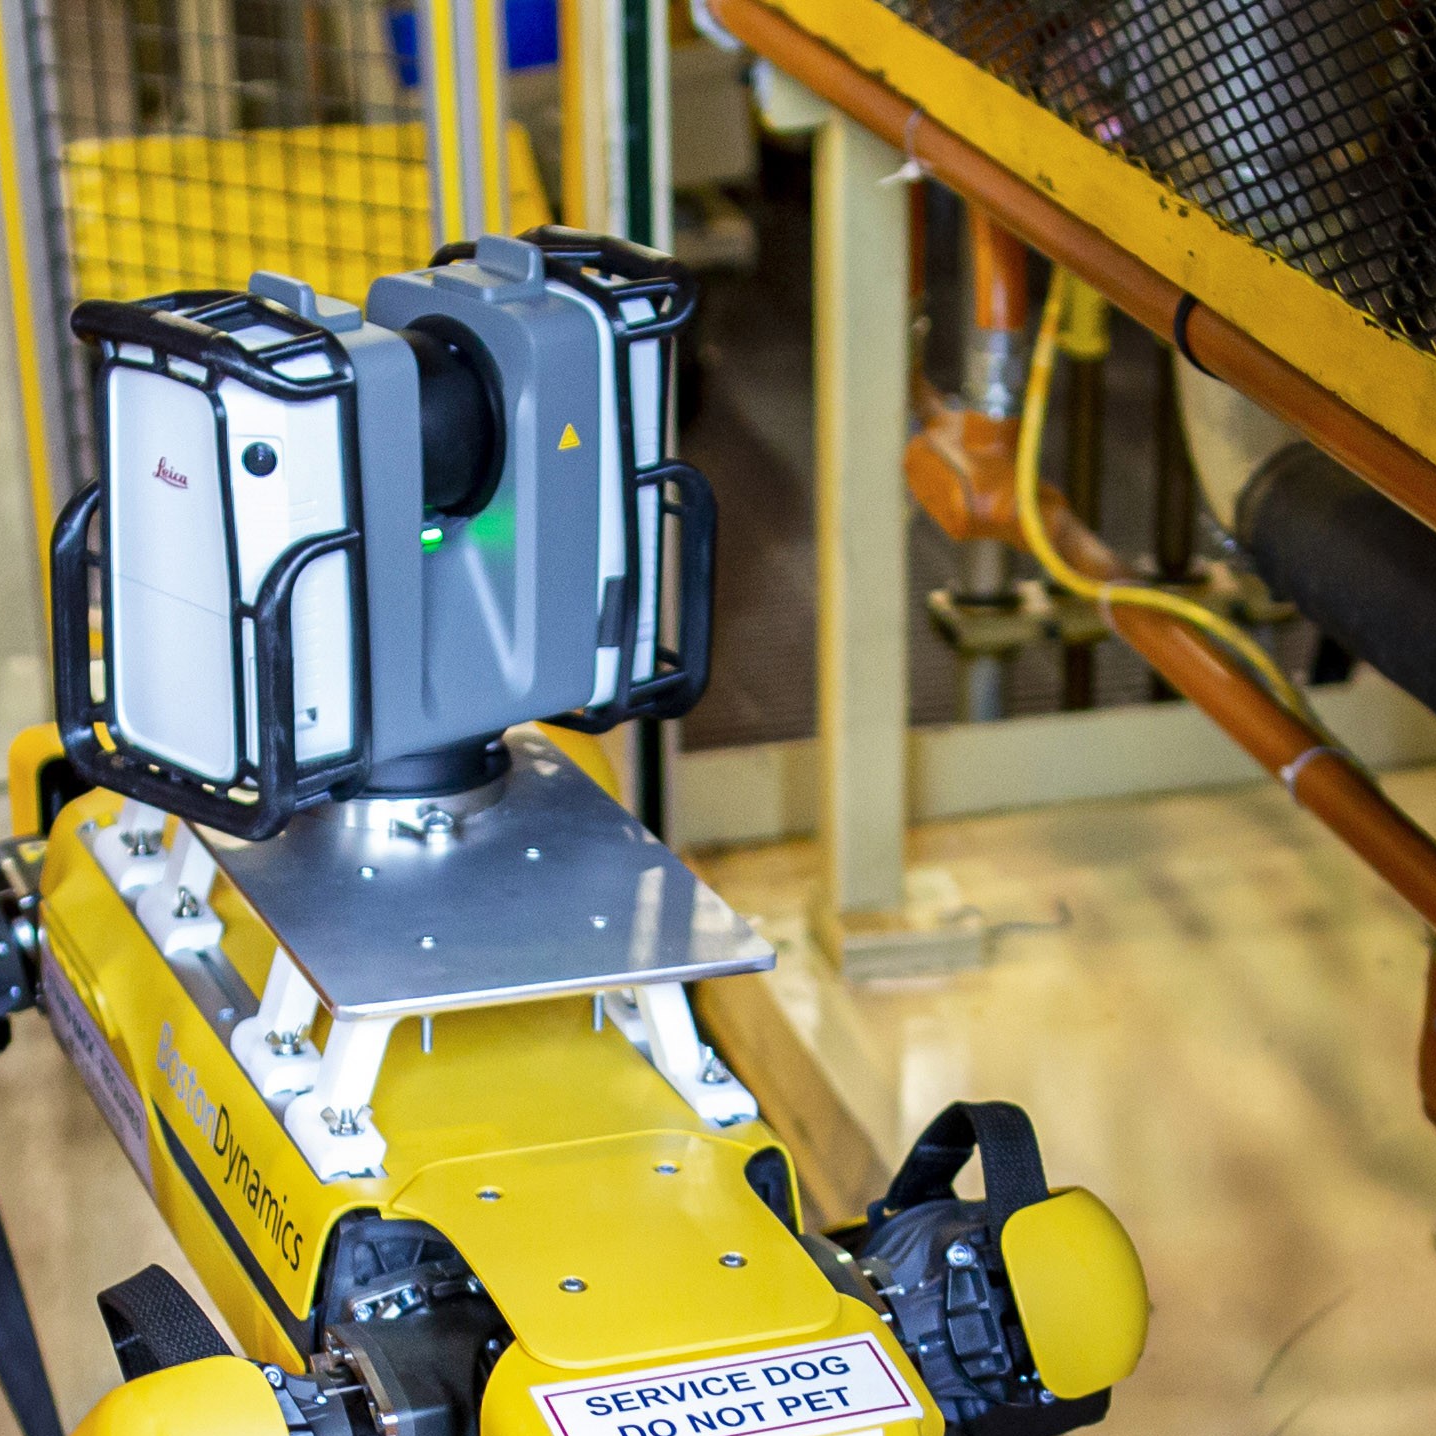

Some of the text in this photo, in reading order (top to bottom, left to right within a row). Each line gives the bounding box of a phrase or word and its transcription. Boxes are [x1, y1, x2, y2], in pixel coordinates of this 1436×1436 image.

[152, 456, 188, 489] Leica
[585, 1355, 851, 1417] SERVICE DOG
[686, 1402, 767, 1433] NOT
[777, 1386, 852, 1418] PET
